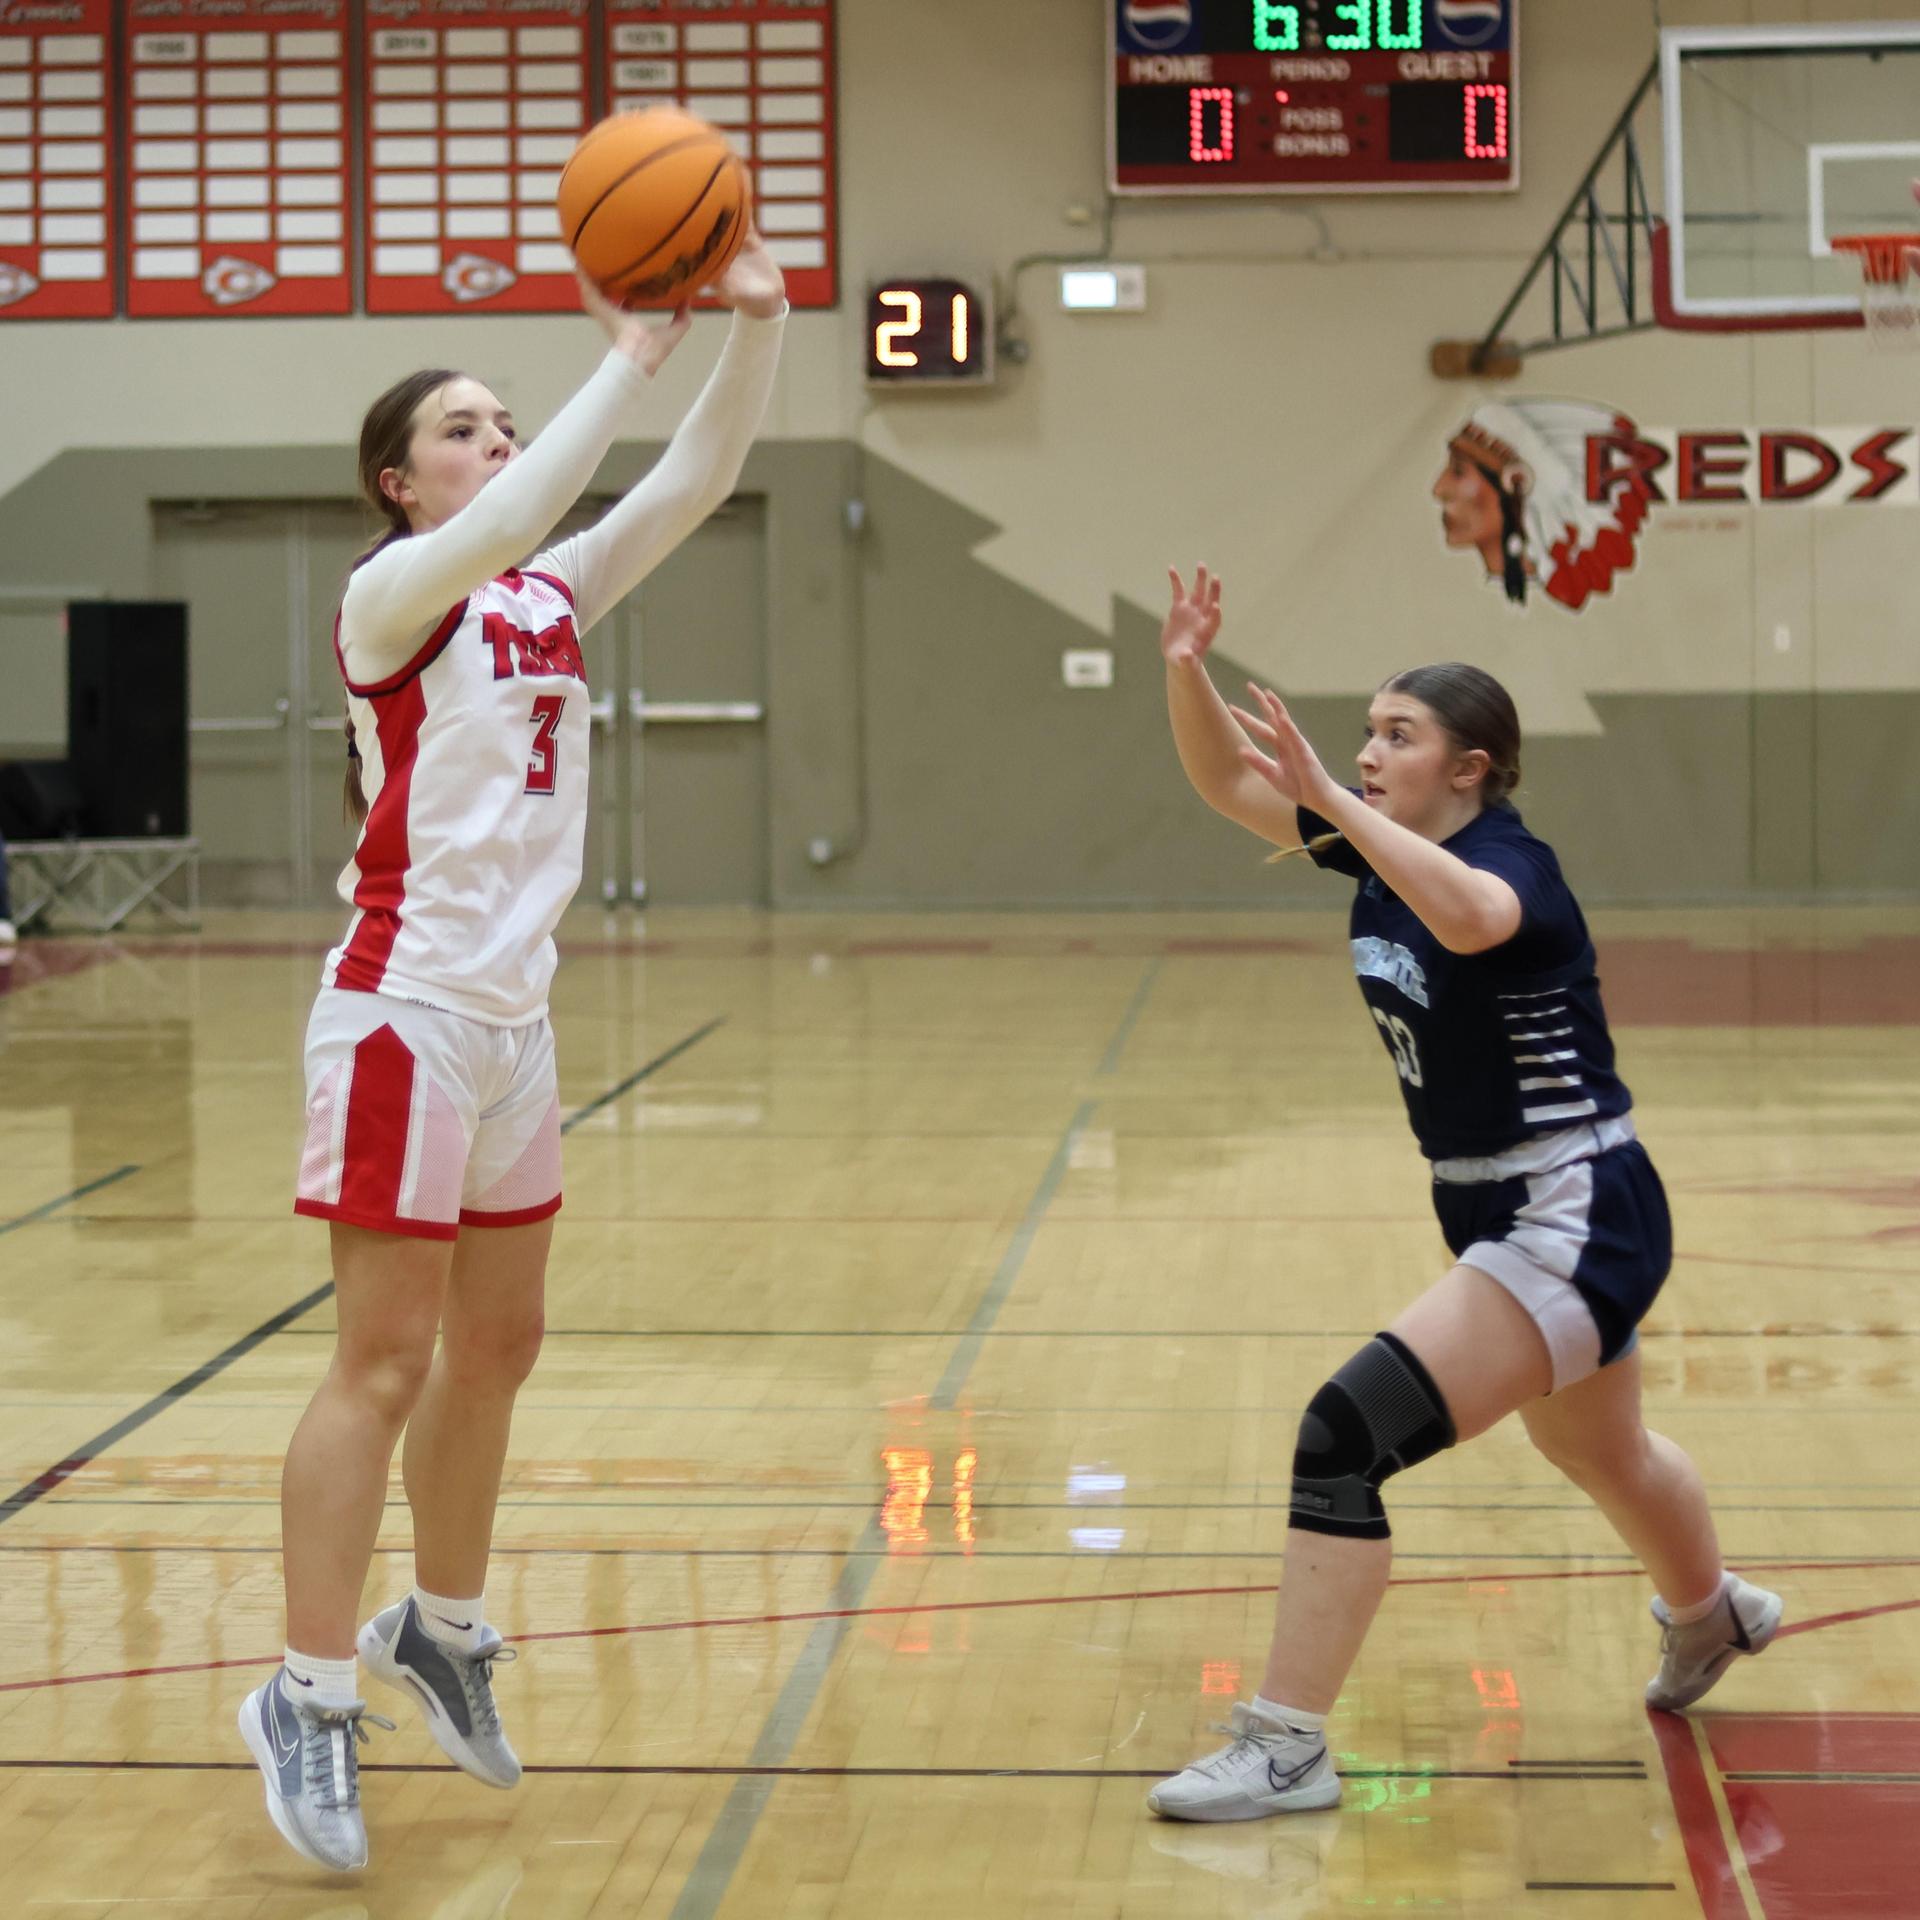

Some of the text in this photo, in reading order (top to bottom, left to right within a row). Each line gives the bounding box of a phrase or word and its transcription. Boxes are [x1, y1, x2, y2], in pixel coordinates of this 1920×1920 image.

[1129, 55, 1213, 83] HOME
[1270, 58, 1351, 81] PERIOD
[1399, 52, 1495, 80] GUEST
[1190, 88, 1234, 161] 0
[1273, 133, 1350, 156] BONUS
[1464, 85, 1507, 158] 0
[876, 290, 968, 367] 21
[1585, 427, 1914, 502] REDS
[524, 694, 567, 795] 3
